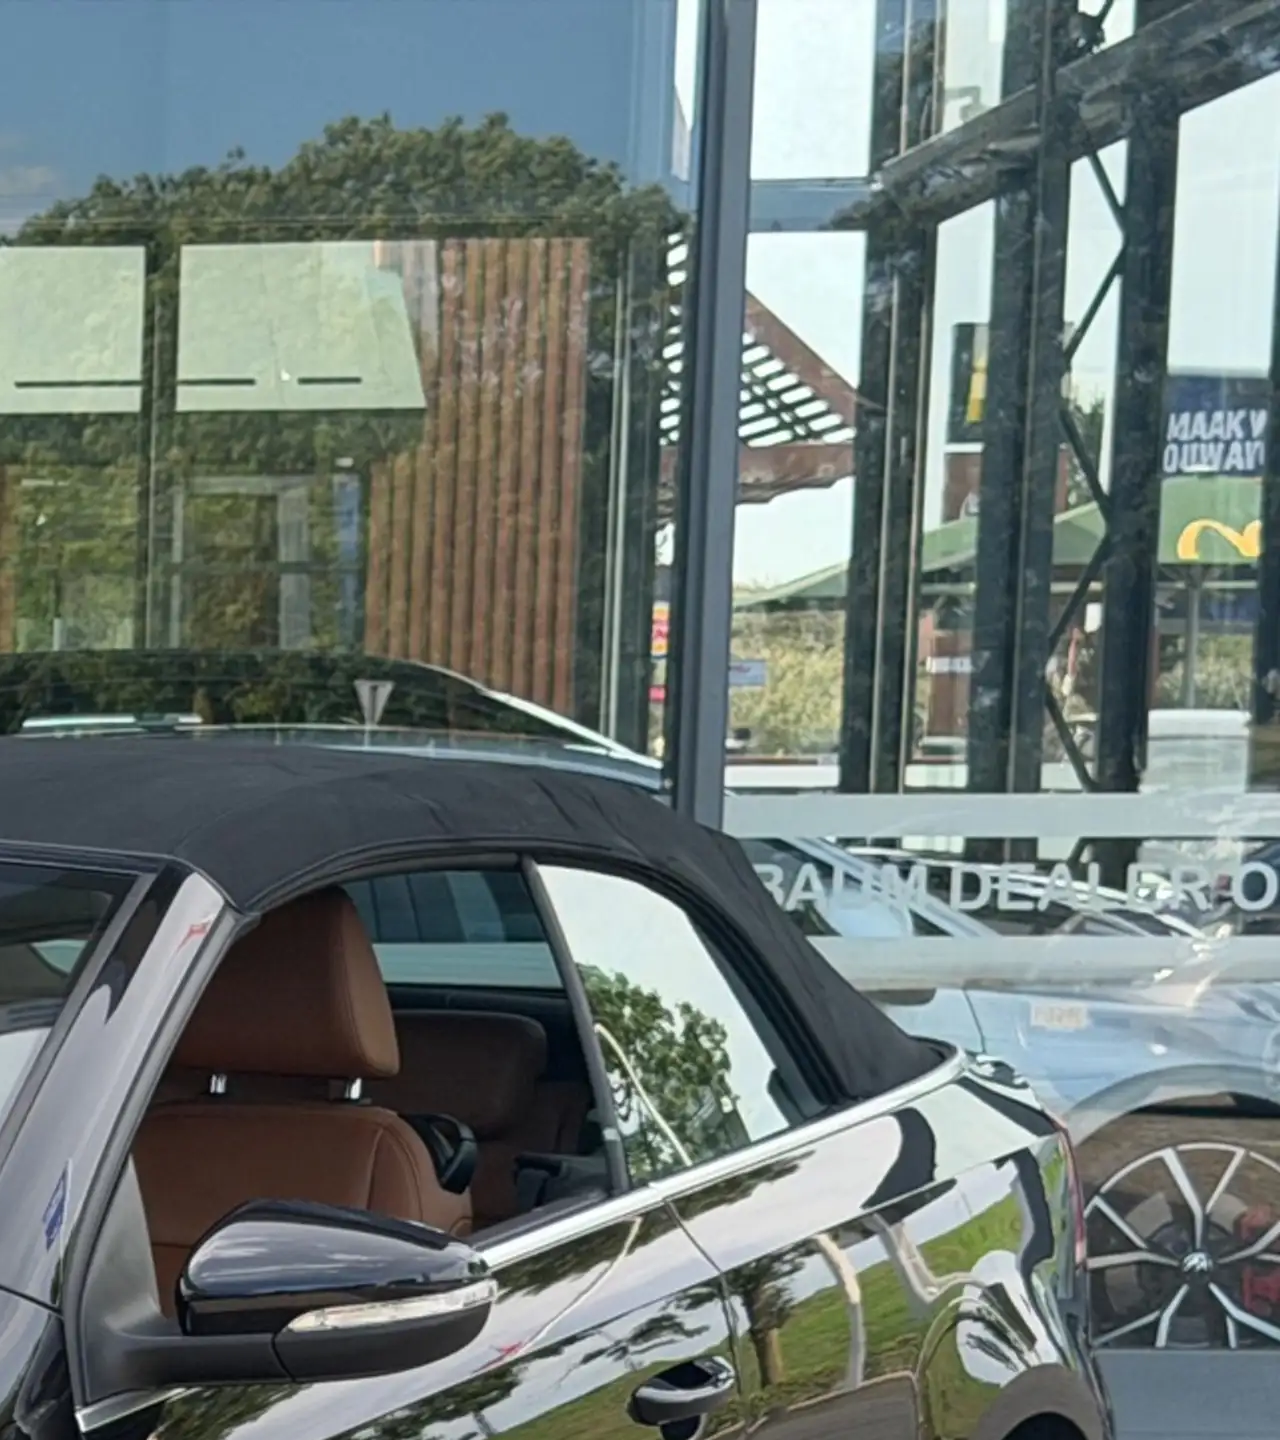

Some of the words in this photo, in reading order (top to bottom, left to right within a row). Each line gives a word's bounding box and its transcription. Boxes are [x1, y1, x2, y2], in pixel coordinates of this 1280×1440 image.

[1167, 409, 1247, 441] MAAK
[950, 861, 1211, 912] DEALER
[1231, 860, 1278, 911] O
